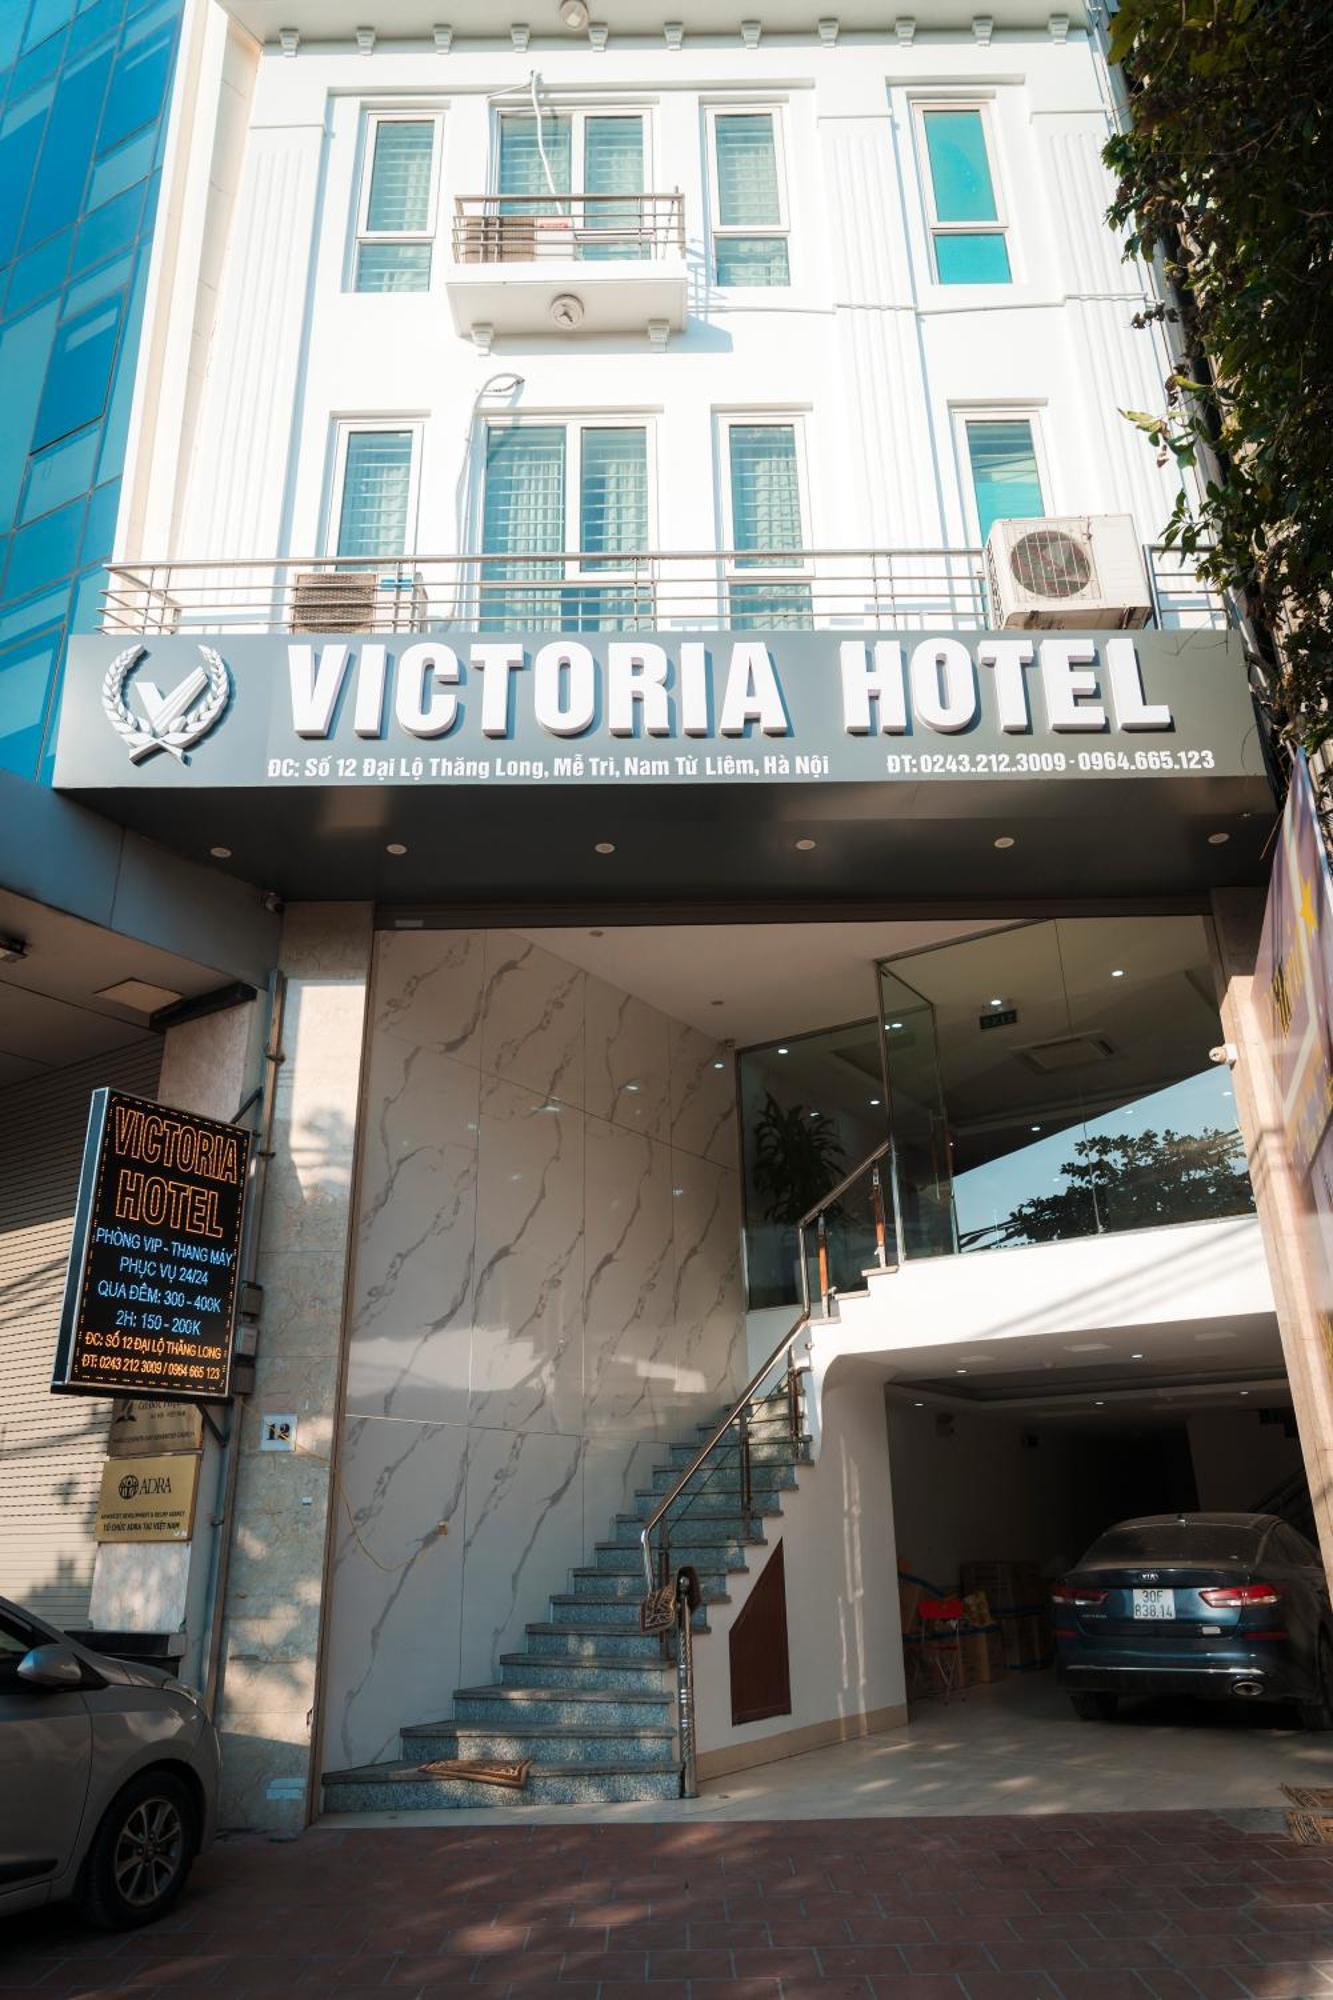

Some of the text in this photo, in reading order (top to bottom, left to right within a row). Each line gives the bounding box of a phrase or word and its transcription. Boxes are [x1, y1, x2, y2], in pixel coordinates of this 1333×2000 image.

[287, 638, 1171, 737] VICTORIA HOTEL
[267, 758, 300, 777] ĐC:
[305, 755, 333, 777] Số
[336, 758, 357, 777] 12
[362, 757, 395, 781] Đại
[400, 757, 424, 781] Lộ
[429, 757, 490, 779] Thăng
[495, 757, 550, 779] Long,
[554, 753, 585, 777] Mễ
[624, 757, 669, 776] Nam
[675, 755, 698, 776] Từ
[705, 755, 760, 777] Liêm,
[764, 755, 790, 776] Hà
[795, 755, 829, 778] Nội
[887, 754, 918, 774] ĐT:
[920, 753, 1066, 773] 0243.212.3009
[1078, 750, 1215, 771] 0964.665.123
[115, 1106, 237, 1184] VICTORIA
[115, 1169, 223, 1238] HOTEL
[96, 1226, 141, 1249] PHÒNG
[144, 1236, 163, 1252] VIP
[171, 1242, 209, 1262] THANG
[210, 1247, 233, 1267] MÁY
[119, 1256, 209, 1286] PHỤC VỤ 24/24
[97, 1280, 127, 1299] QUA
[129, 1282, 162, 1304] ĐÊM:
[164, 1290, 185, 1307] 300
[194, 1295, 221, 1313] 400K
[115, 1310, 137, 1327] 2H:
[141, 1313, 162, 1330] 150
[171, 1318, 201, 1335] 200K
[84, 1331, 103, 1346] ĐC:
[104, 1330, 121, 1348] SỐ
[122, 1336, 133, 1350] 12
[134, 1338, 150, 1355] ĐẠI
[166, 1339, 197, 1357] THĂNG
[197, 1344, 222, 1360] LONG
[81, 1354, 98, 1367] ĐT:
[99, 1356, 121, 1370] 0243
[122, 1358, 140, 1372] 212
[206, 1367, 220, 1380] 123
[266, 1423, 290, 1440] 12
[140, 1476, 172, 1495] ADRA
[1142, 1590, 1163, 1603] 30F
